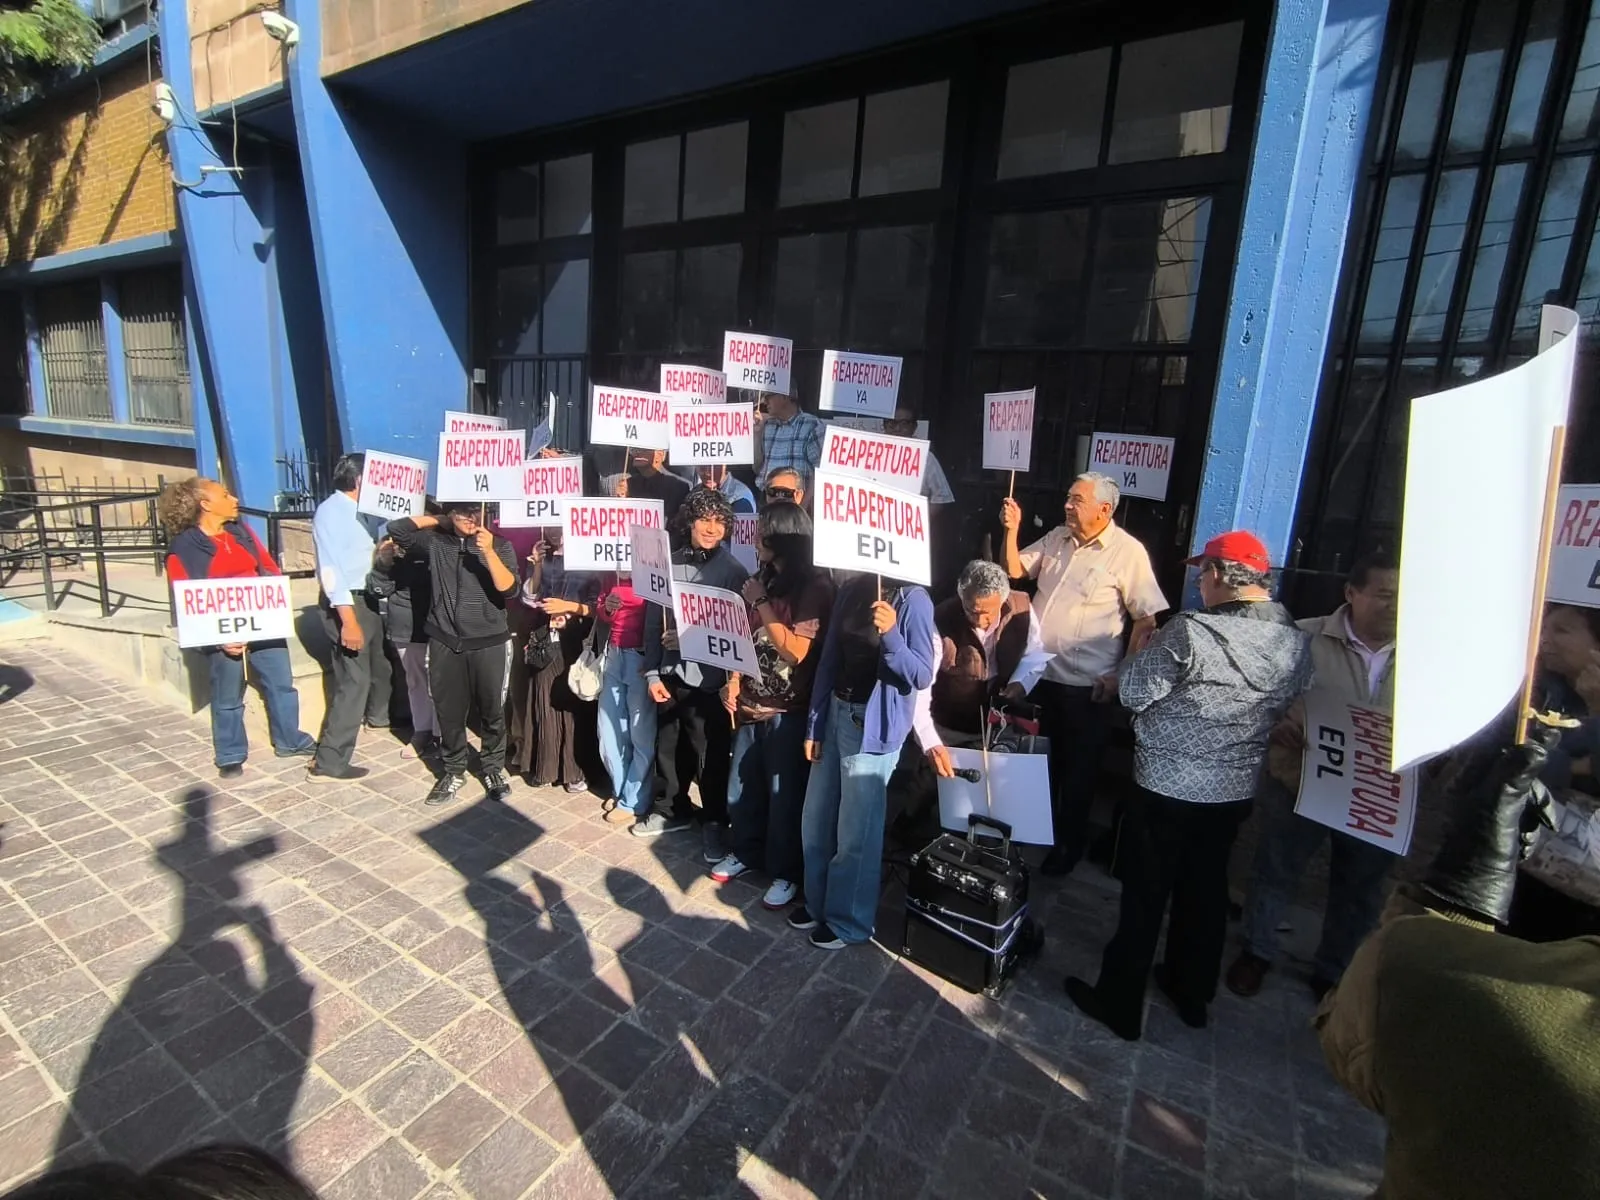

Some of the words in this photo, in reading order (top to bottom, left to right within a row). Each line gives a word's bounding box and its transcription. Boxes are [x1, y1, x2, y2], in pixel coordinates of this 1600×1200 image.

[729, 340, 789, 369] REAPERTURA
[666, 370, 724, 397] REAPERTURA
[743, 368, 776, 386] PREPA
[832, 360, 893, 388] REAPERTURA
[598, 393, 668, 424] REAPERTURA
[856, 390, 867, 404] YA
[624, 424, 637, 440] YA
[675, 412, 750, 437] REAPERTURA
[445, 438, 521, 468] REAPERTURA
[693, 441, 733, 457] PREPA
[828, 434, 921, 478] REAPERTURA
[1010, 439, 1019, 460] YA
[1094, 438, 1169, 470] REAPERTURA
[368, 458, 426, 496] REAPERTURA
[474, 473, 489, 492] YA
[1123, 471, 1137, 488] YA
[378, 492, 411, 515] PREPA
[527, 500, 560, 517] EPL
[823, 482, 924, 541] REAPERTURA
[571, 507, 660, 536] REAPERTURA
[735, 519, 758, 546] REAP
[594, 543, 632, 561] PREP
[857, 533, 900, 565] EPL
[650, 572, 672, 597] EPL
[184, 584, 287, 616] REAPERTURA
[218, 616, 262, 634] EPL
[680, 591, 750, 641] REAPERTUR
[707, 634, 743, 662] EPL
[1317, 725, 1345, 778] EPL
[1346, 704, 1402, 838] REAPERTURA
